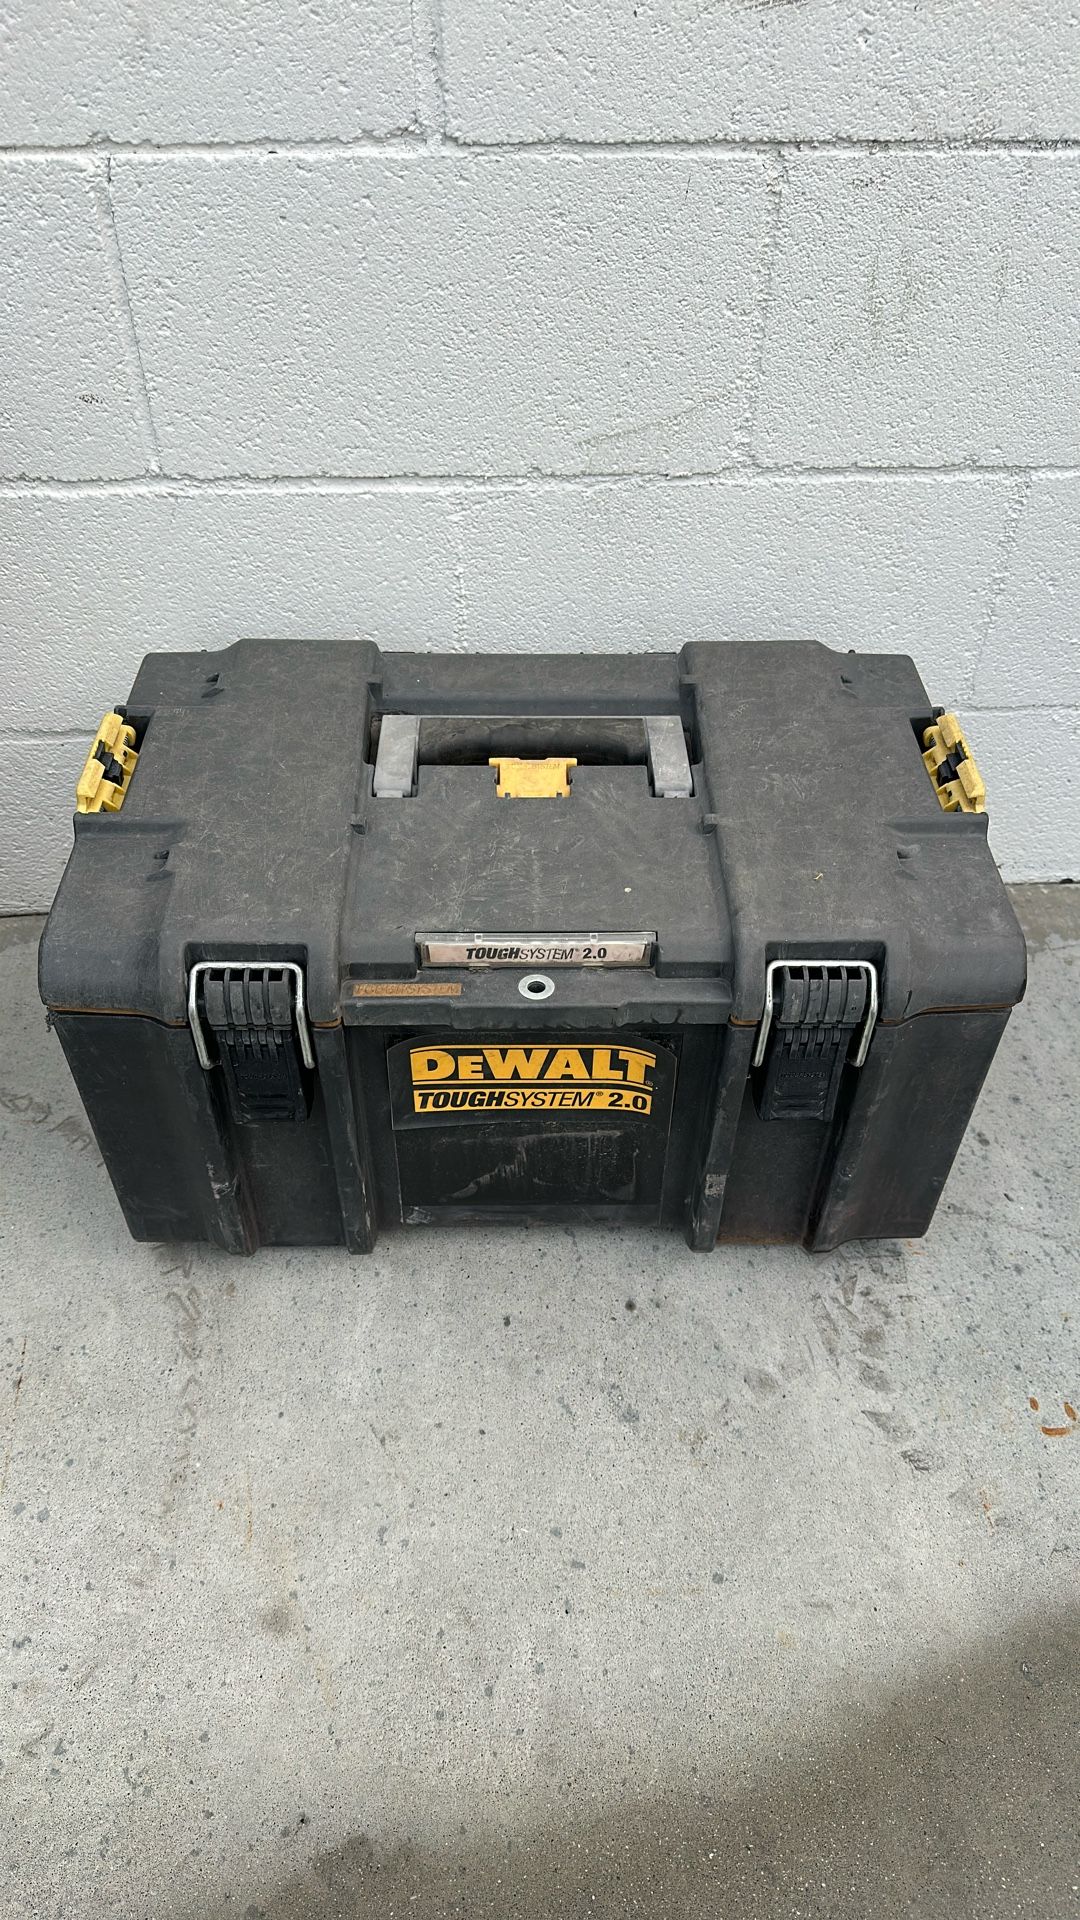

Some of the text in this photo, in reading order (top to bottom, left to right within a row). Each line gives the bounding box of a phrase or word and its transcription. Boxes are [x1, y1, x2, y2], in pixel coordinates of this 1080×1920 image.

[466, 947, 607, 960] TOUGHSYSTEM 2.0
[608, 1092, 648, 1110] 2.0
